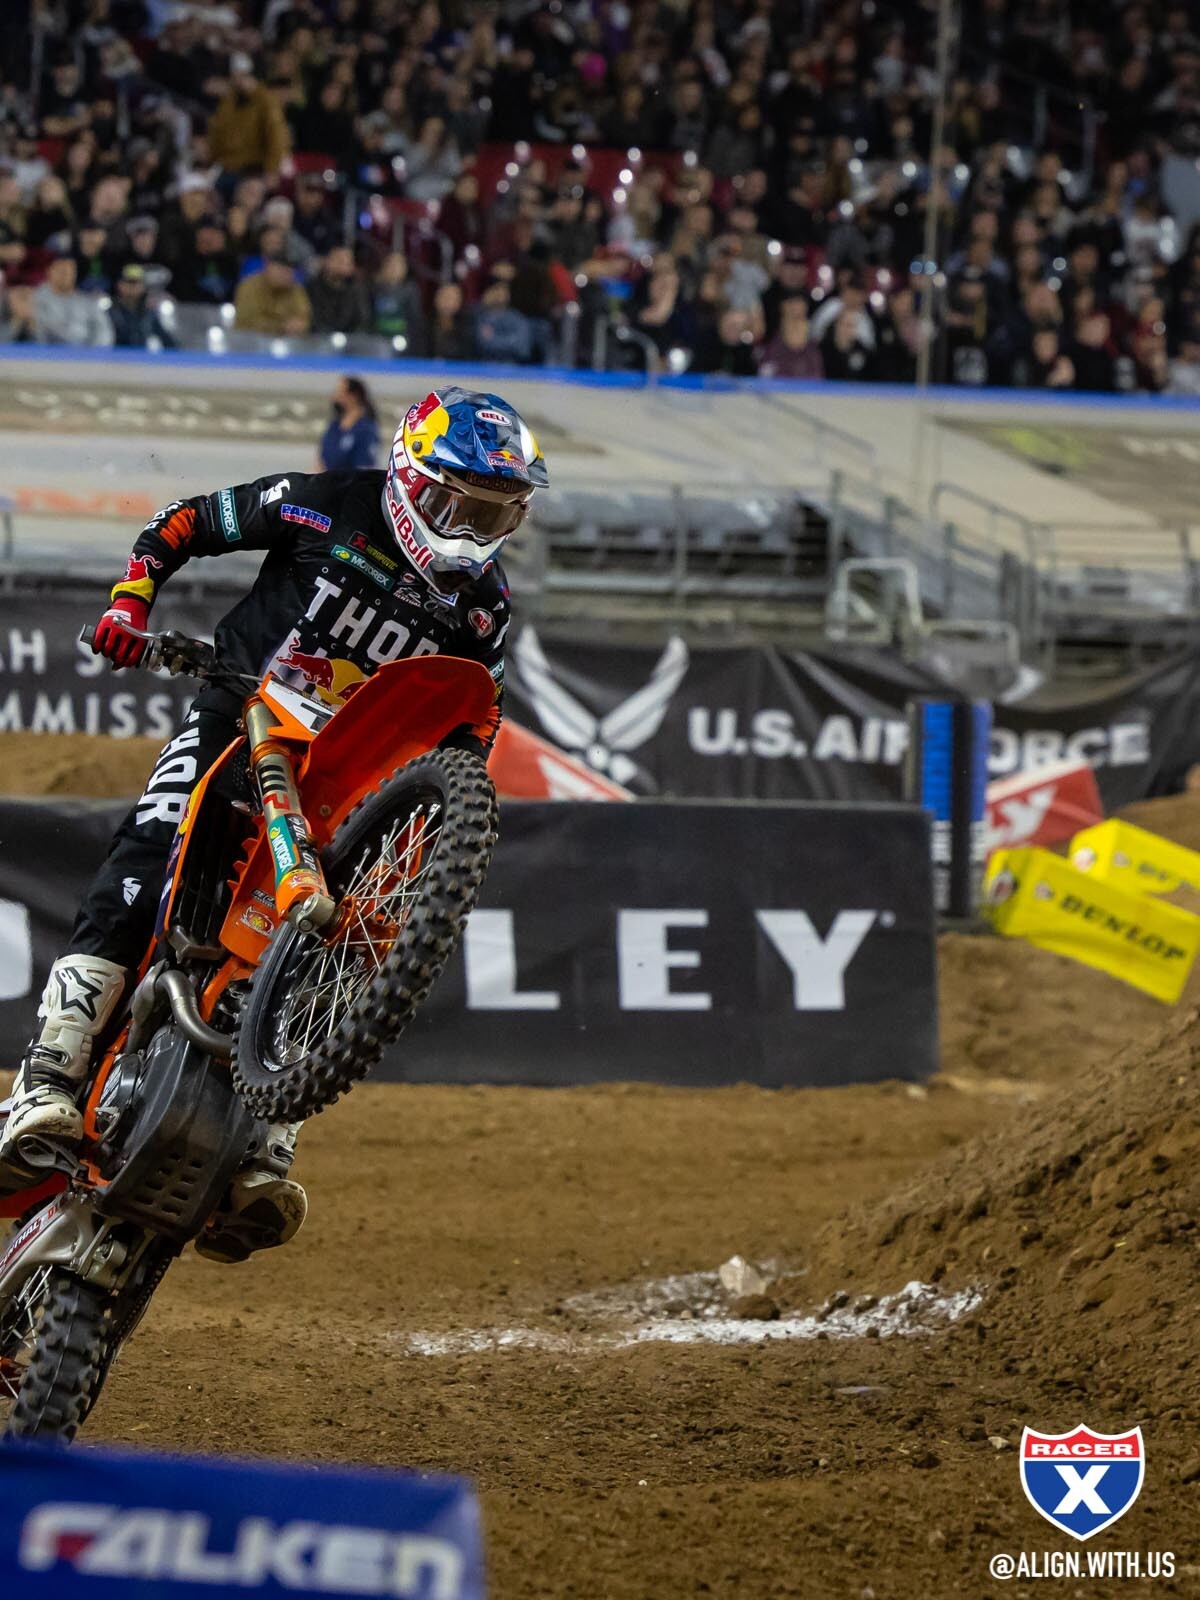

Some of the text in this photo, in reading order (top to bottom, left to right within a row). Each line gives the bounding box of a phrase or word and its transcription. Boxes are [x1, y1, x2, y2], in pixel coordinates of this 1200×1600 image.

[481, 411, 508, 424] BELL
[219, 489, 237, 536] MOTOREX
[282, 504, 331, 526] PARTS
[397, 516, 436, 571] Bull
[350, 556, 391, 585] MOTOREX
[986, 722, 1151, 773] ORCE
[271, 832, 294, 872] MOTOREX
[1060, 894, 1186, 960] DUNLOP
